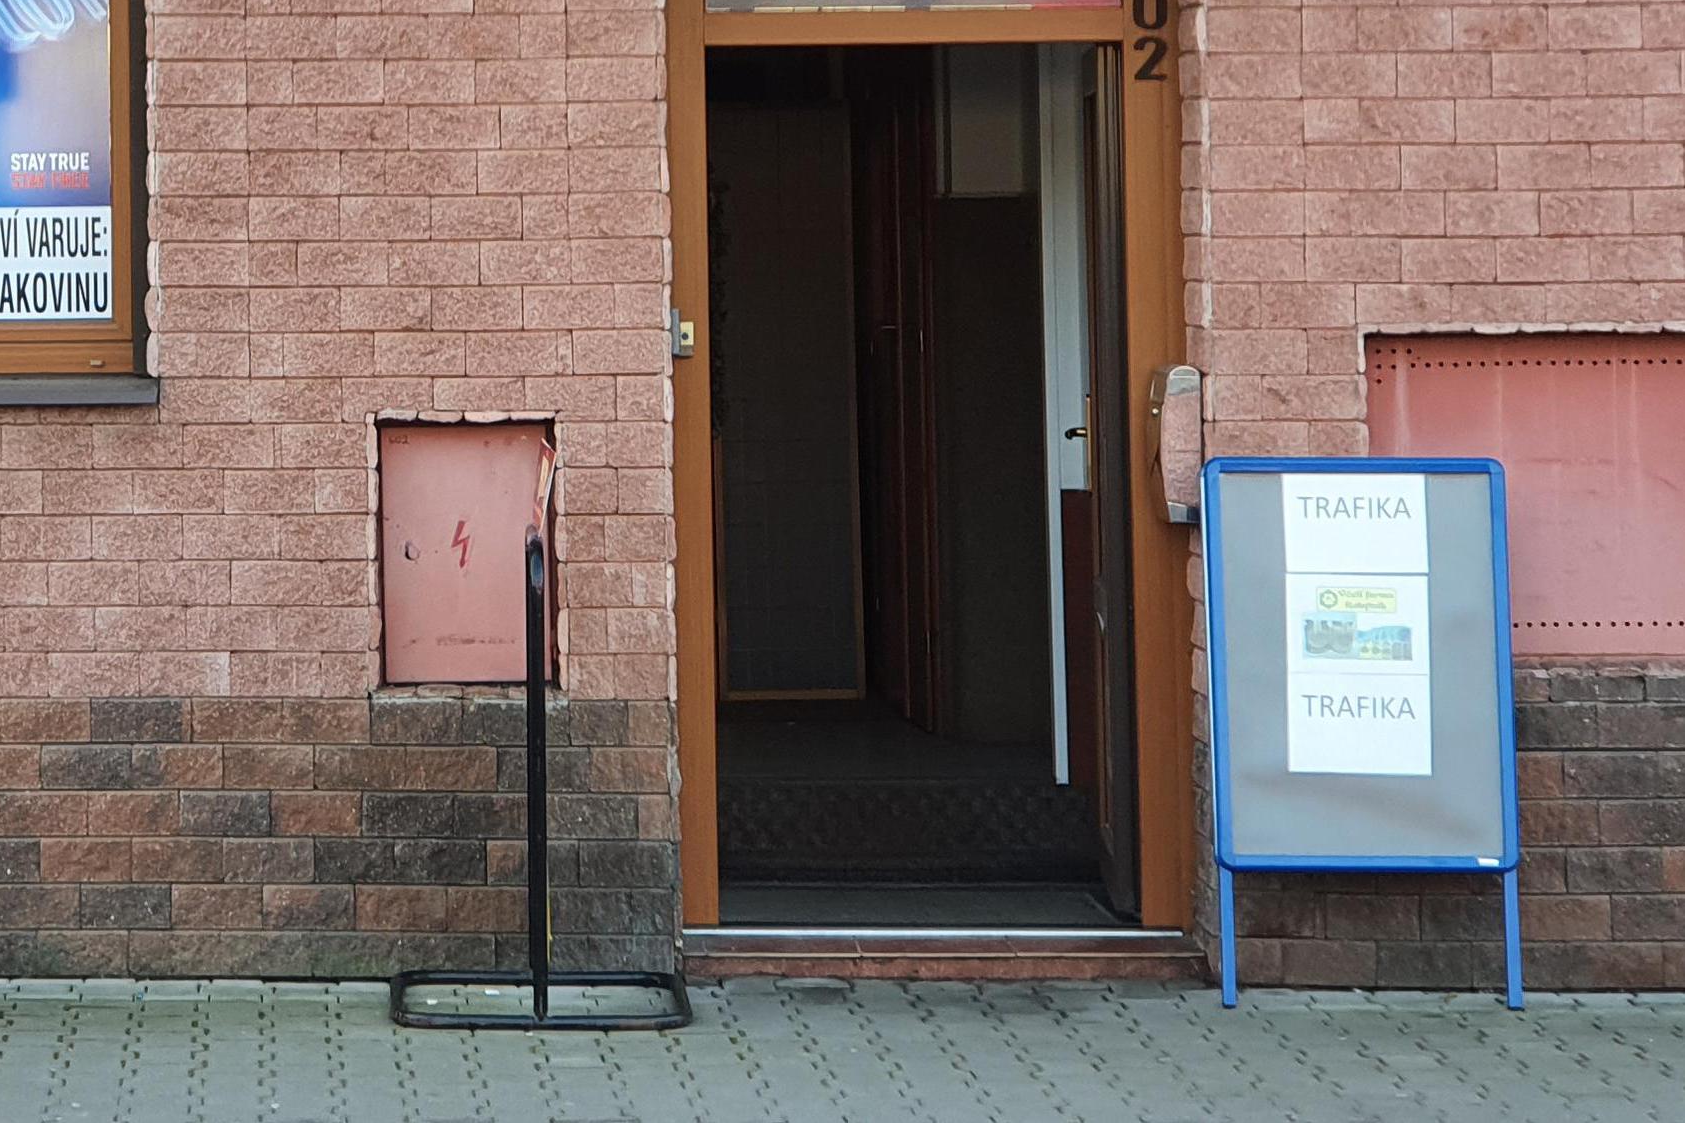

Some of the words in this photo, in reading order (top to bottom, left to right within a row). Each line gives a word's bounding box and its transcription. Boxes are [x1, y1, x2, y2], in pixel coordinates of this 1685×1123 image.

[10, 152, 47, 171] STAY
[48, 152, 90, 171] TRUE
[26, 216, 108, 259] VARUJE:
[1296, 496, 1412, 519] TRAFIKA
[1301, 694, 1416, 720] TRAFIKA
